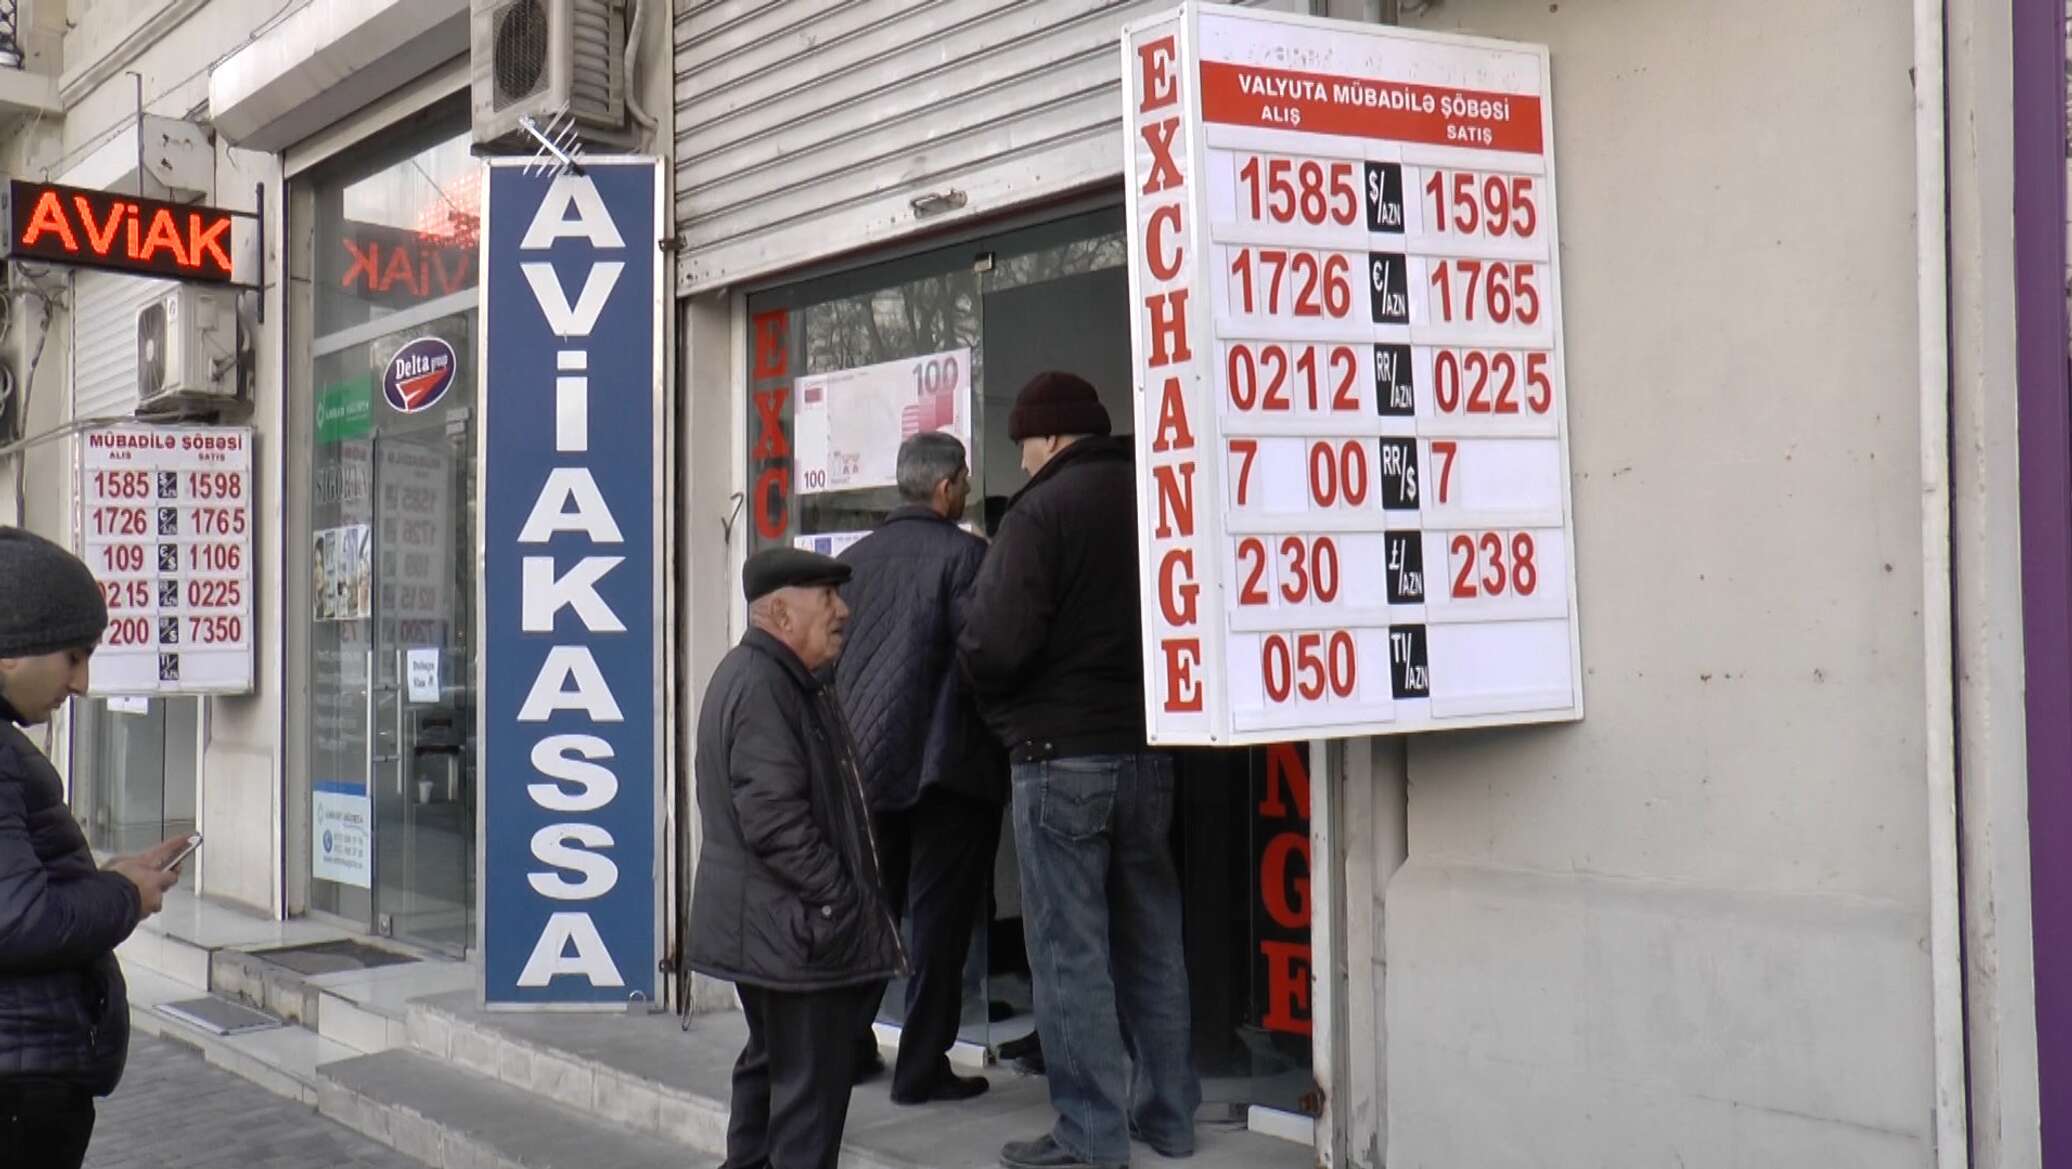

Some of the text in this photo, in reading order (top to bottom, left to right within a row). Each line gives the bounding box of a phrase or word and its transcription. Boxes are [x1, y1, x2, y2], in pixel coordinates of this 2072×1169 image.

[1239, 73, 1511, 121] VALYUTA MÜBADİLƏ ŞÖBƏSİ
[1261, 104, 1494, 146] ALIŞ SATIŞ
[1241, 156, 1358, 224] 1585
[1427, 170, 1537, 237] 1595
[1232, 247, 1352, 317] 1726
[1432, 258, 1541, 325] 1765
[396, 354, 429, 380] Delta
[913, 356, 959, 396] 100
[1137, 35, 1204, 712] EXCHANGE
[1228, 344, 1360, 412] 0212
[1435, 348, 1552, 414] 0225
[95, 471, 149, 499] 1585
[190, 472, 240, 500] 1598
[804, 471, 826, 488] 100
[1229, 439, 1259, 506] 7
[1432, 440, 1457, 503] 7
[93, 507, 147, 535] 1726
[192, 508, 245, 534] 1765
[104, 545, 144, 571] 109
[190, 543, 240, 570] 1106
[1451, 531, 1537, 598] 238
[188, 580, 240, 607] 0225
[109, 617, 149, 645] 200
[189, 616, 241, 643] 7350
[1263, 630, 1356, 703] 050
